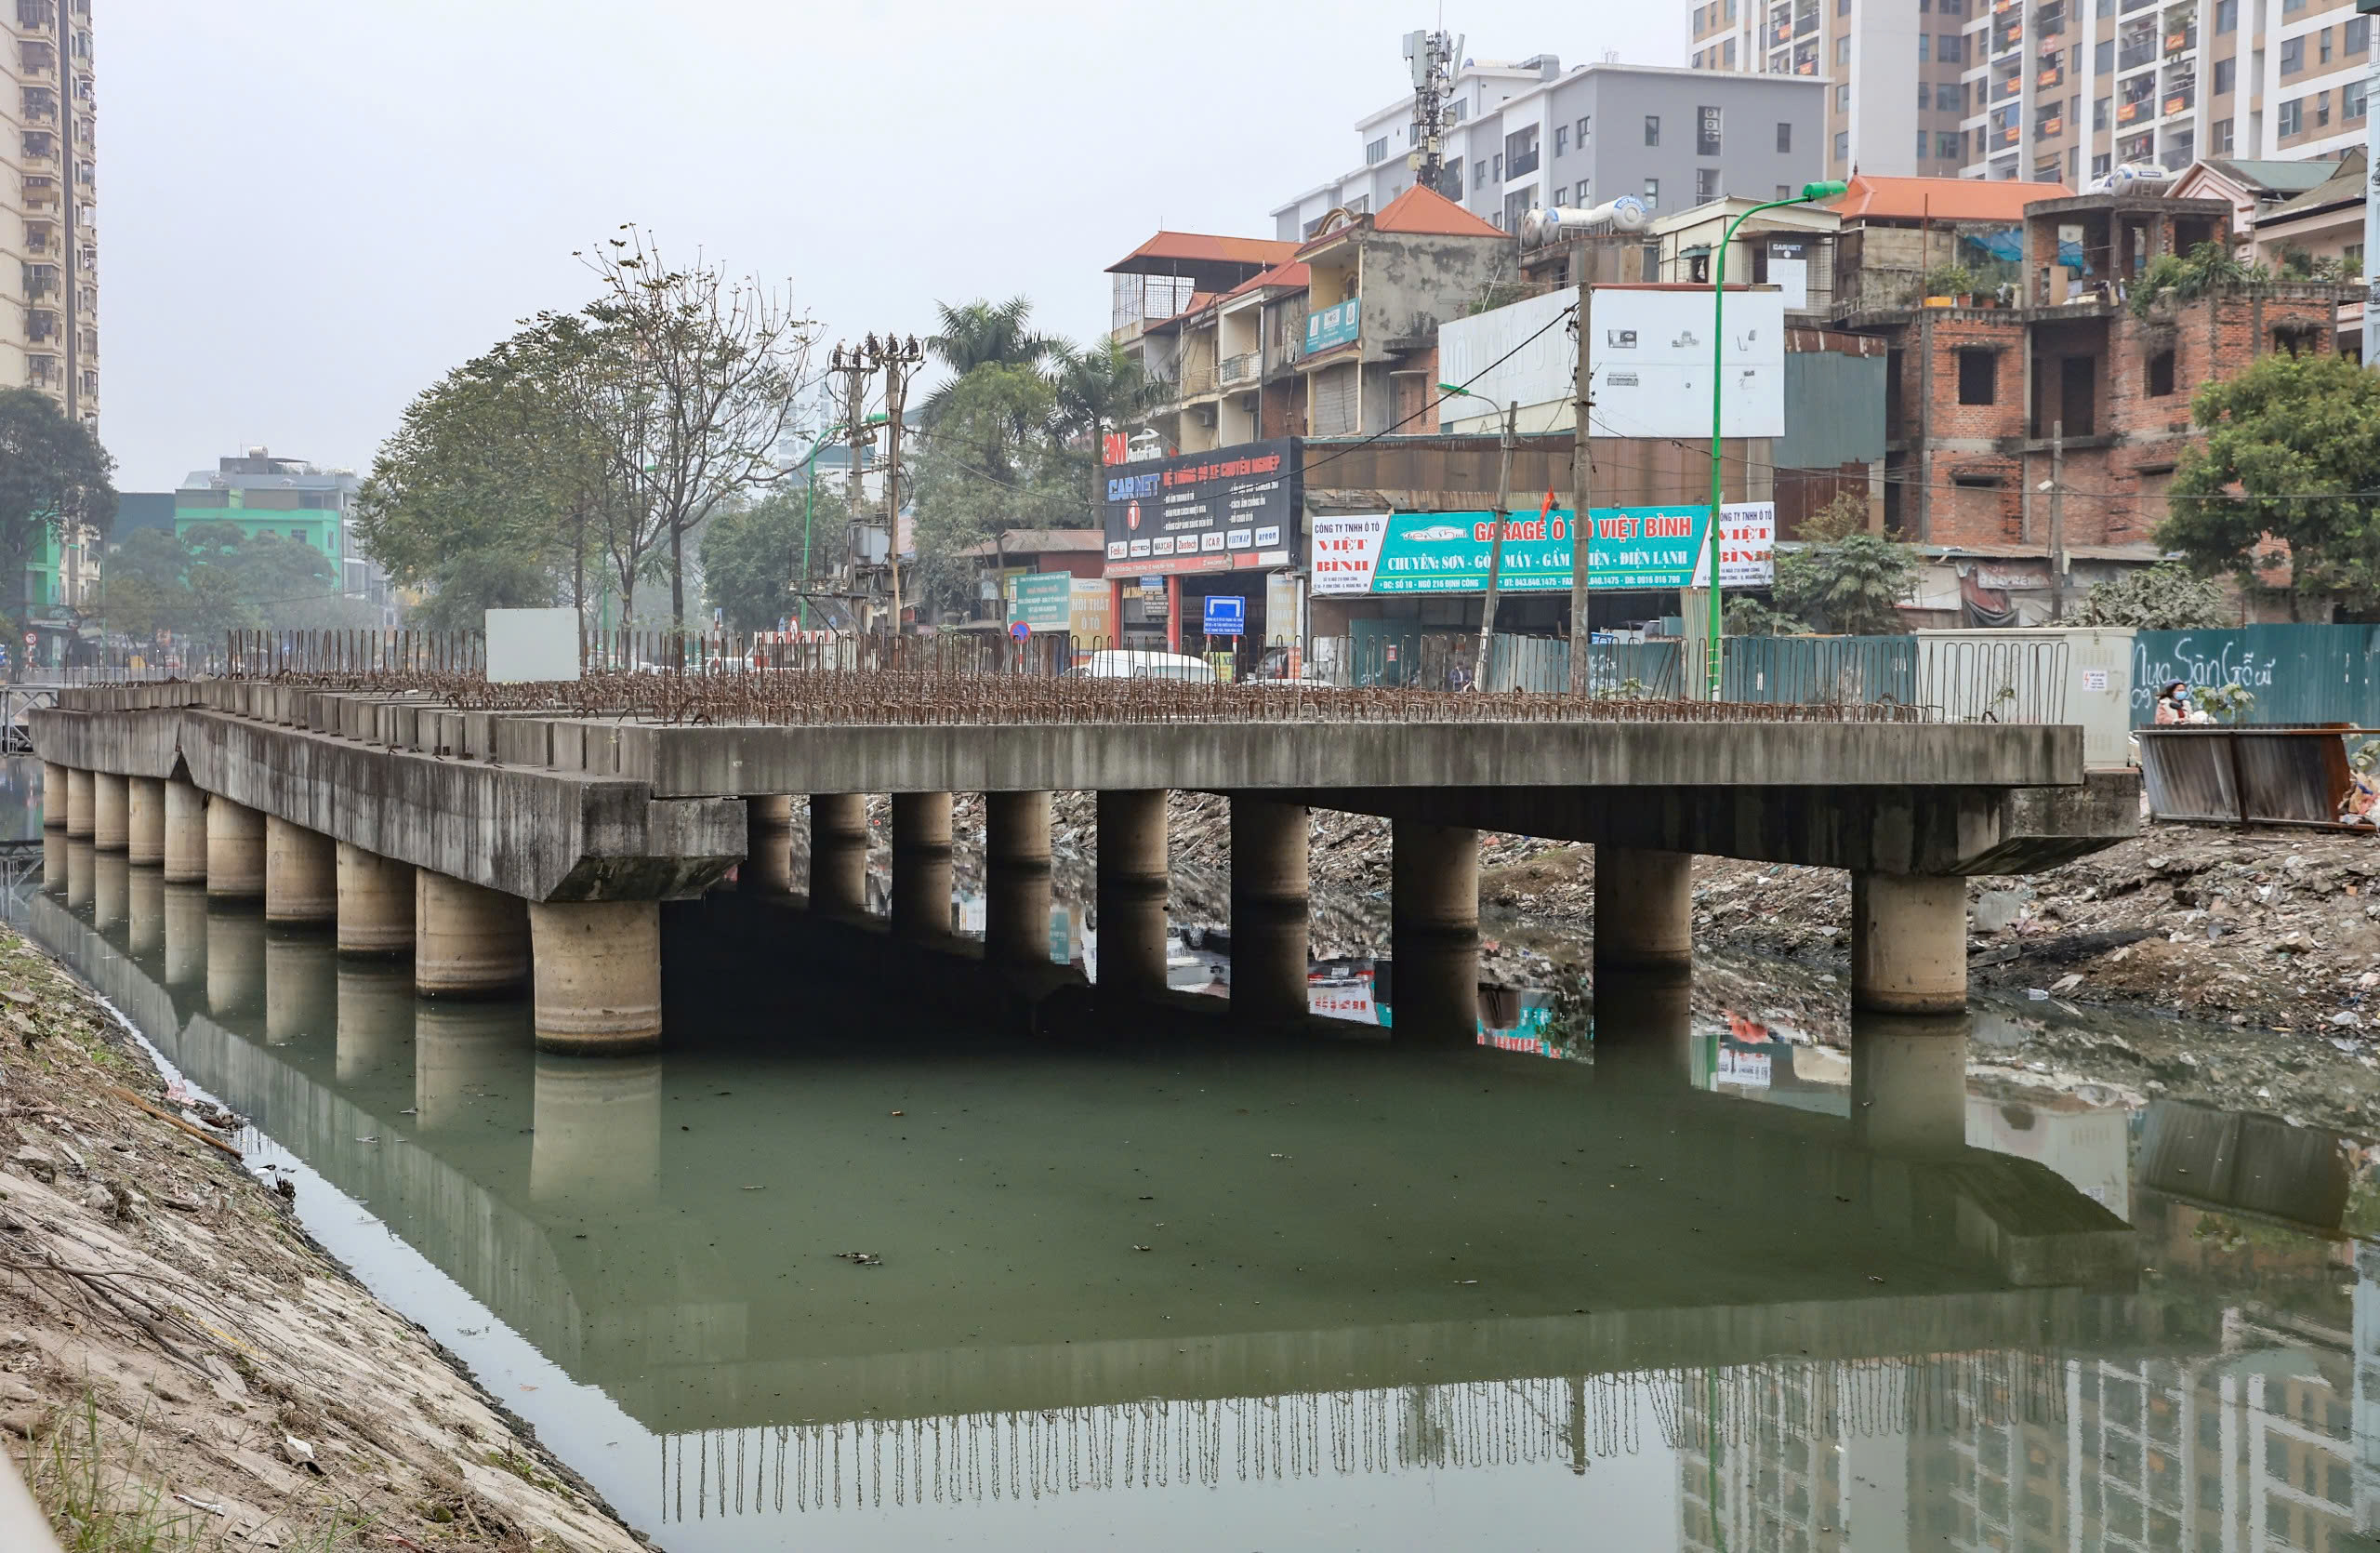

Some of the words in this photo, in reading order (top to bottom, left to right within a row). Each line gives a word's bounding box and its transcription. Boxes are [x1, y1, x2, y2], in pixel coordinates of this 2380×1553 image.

[1104, 431, 1128, 466] 3M
[1128, 445, 1162, 462] AutoFilm
[1108, 472, 1160, 501] CARNET
[1720, 511, 1732, 522] ÔNG
[1734, 512, 1740, 521] TY
[1742, 511, 1757, 521] TNHH
[1765, 509, 1772, 520] TÔ
[1315, 522, 1333, 533] CÔNG
[1335, 524, 1342, 533] TY
[1345, 524, 1363, 532] TNHH
[1365, 523, 1368, 532] Ô
[1371, 521, 1380, 532] TÔ
[1474, 520, 1547, 541] GARAGE
[1552, 516, 1566, 540] Ô
[1599, 514, 1639, 542] VIỆT
[1645, 513, 1692, 538] BÌNH
[1719, 525, 1770, 543] VIỆT
[1259, 531, 1276, 540] areon
[1318, 537, 1368, 553] VIỆT
[1316, 557, 1368, 572] BÌNH
[1388, 552, 1439, 570] CHUYÊN:
[1442, 554, 1465, 569] SƠN
[1504, 551, 1532, 568] MÁY
[1542, 547, 1570, 566] GẦM
[1588, 549, 1609, 570] IỆN
[1620, 548, 1650, 569] ĐIỆN
[1653, 551, 1687, 569] LẠNH
[1090, 595, 1109, 610] THẤT
